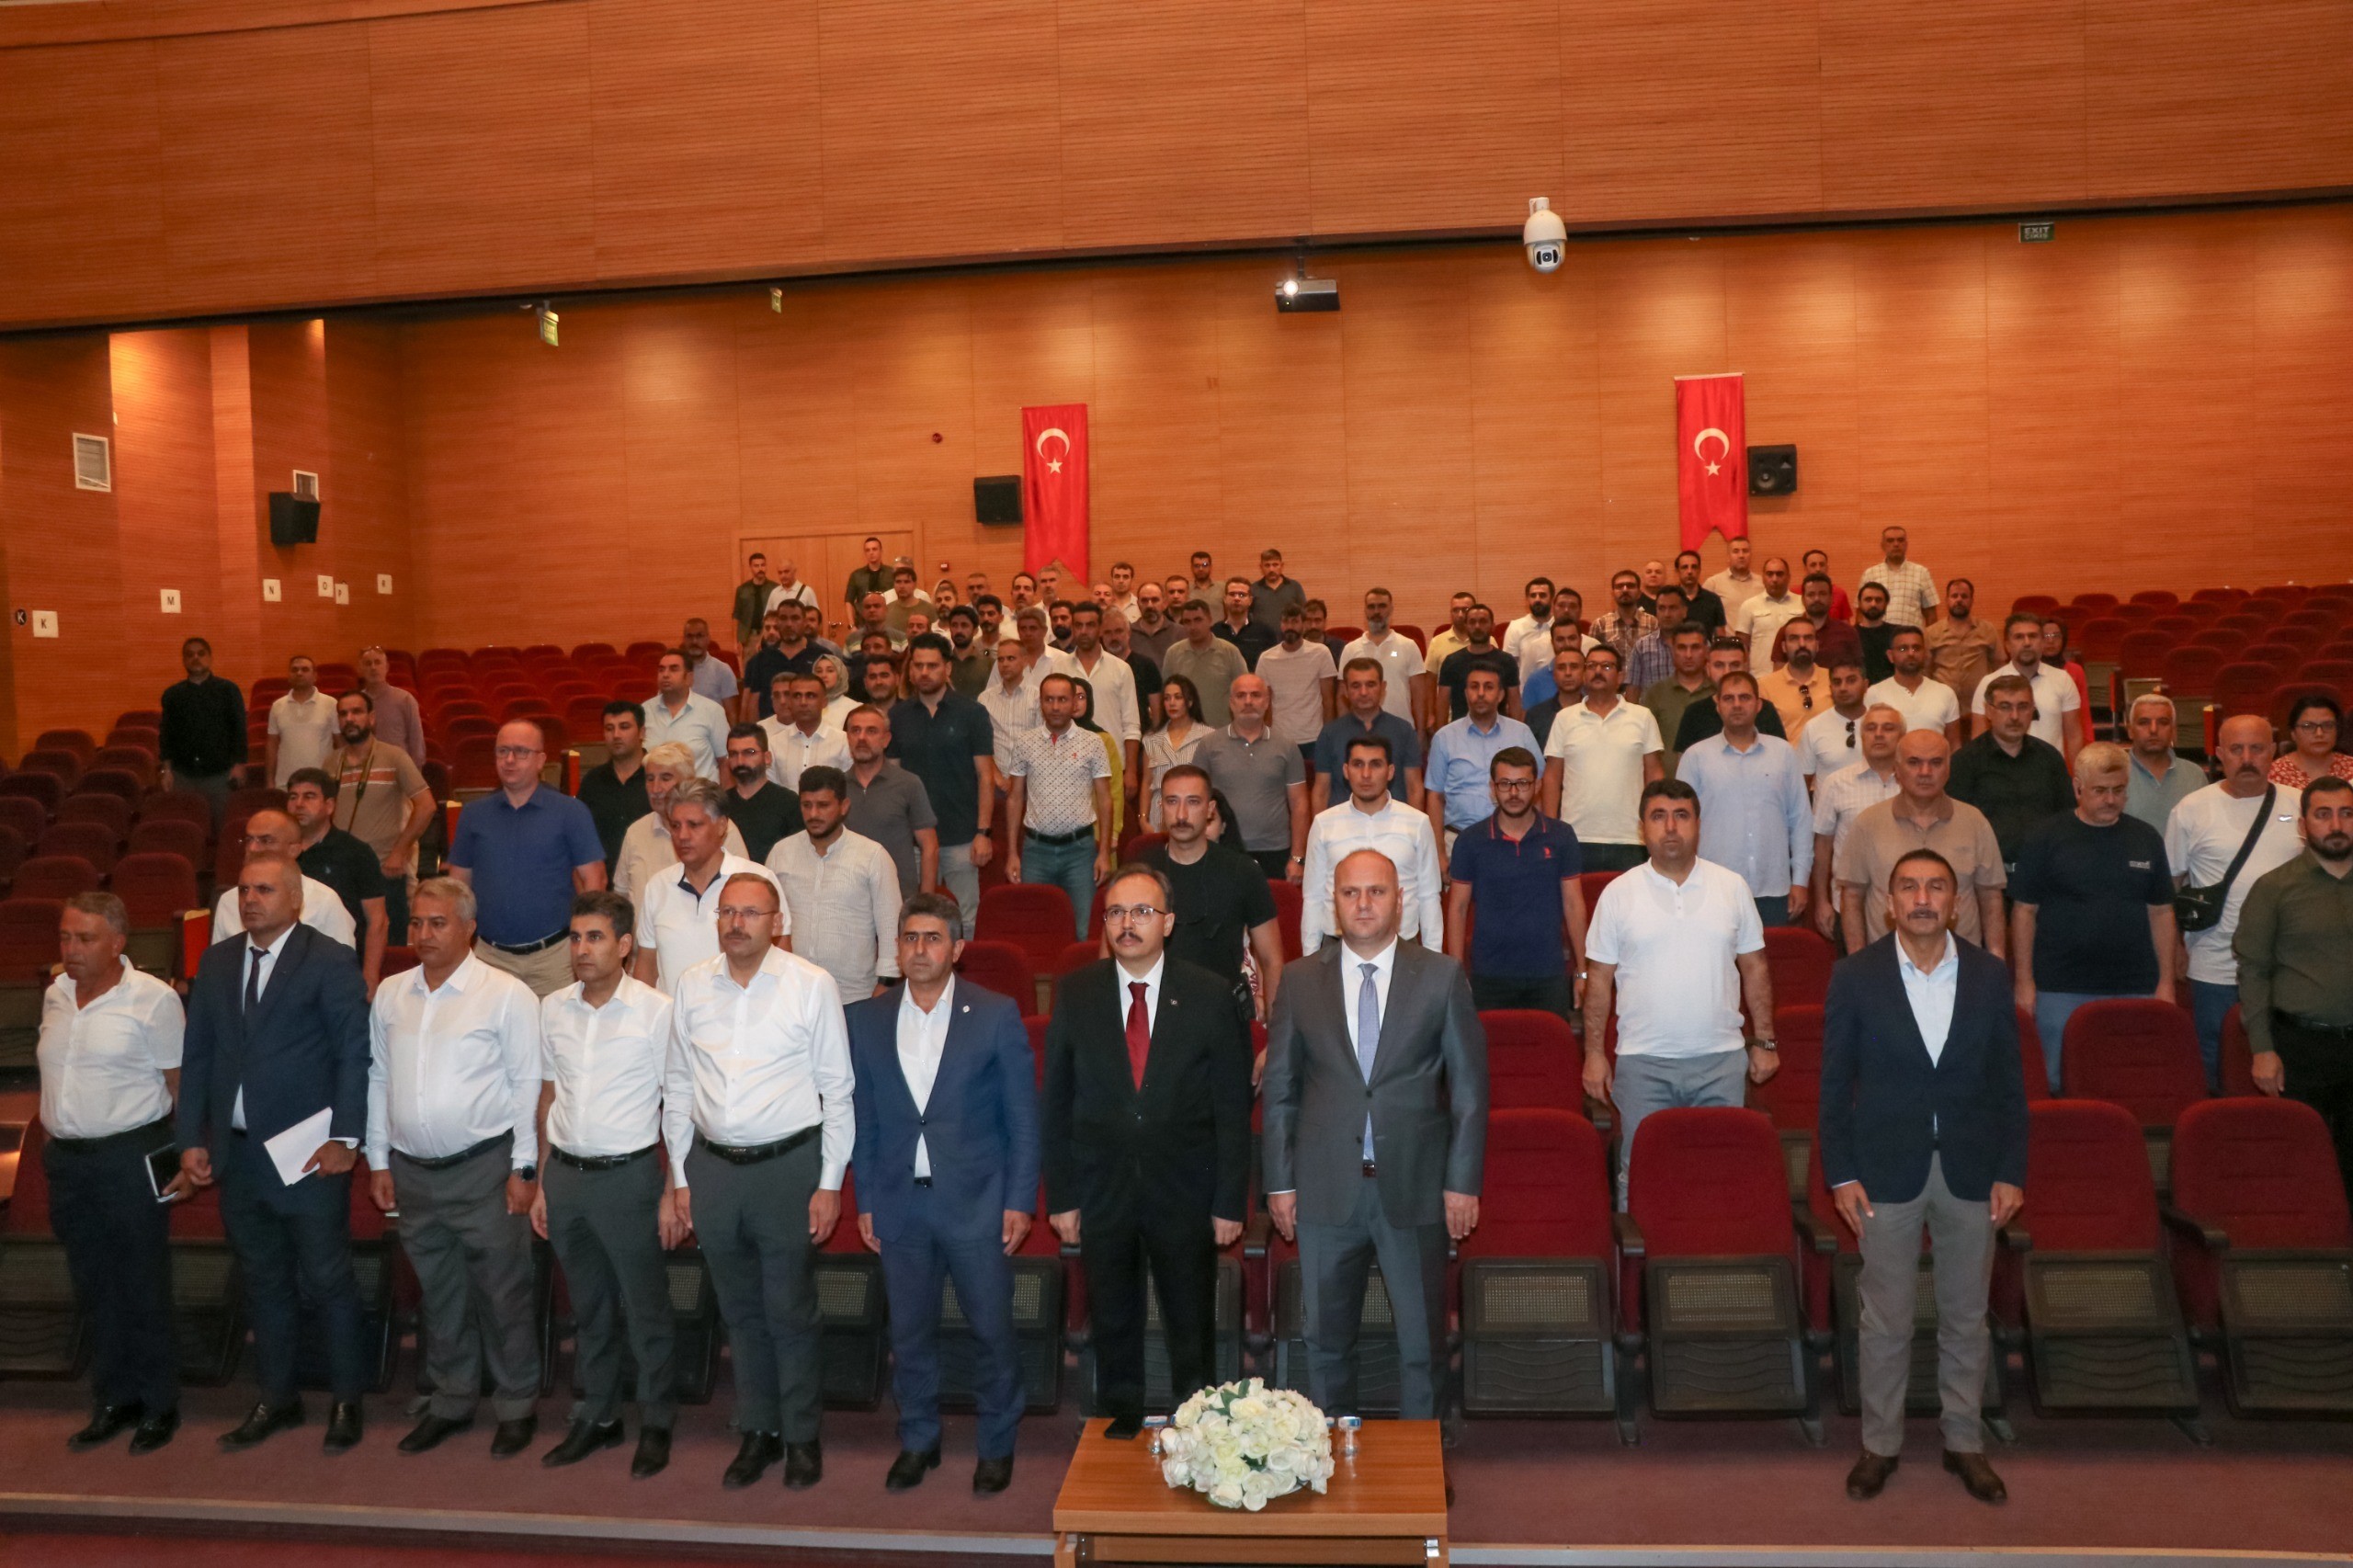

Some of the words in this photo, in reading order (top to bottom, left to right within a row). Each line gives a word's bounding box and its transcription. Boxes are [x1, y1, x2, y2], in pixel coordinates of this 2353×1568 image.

[2024, 226, 2050, 234] EXIT
[268, 585, 275, 595] N
[167, 596, 175, 606] M
[40, 618, 48, 630] K
